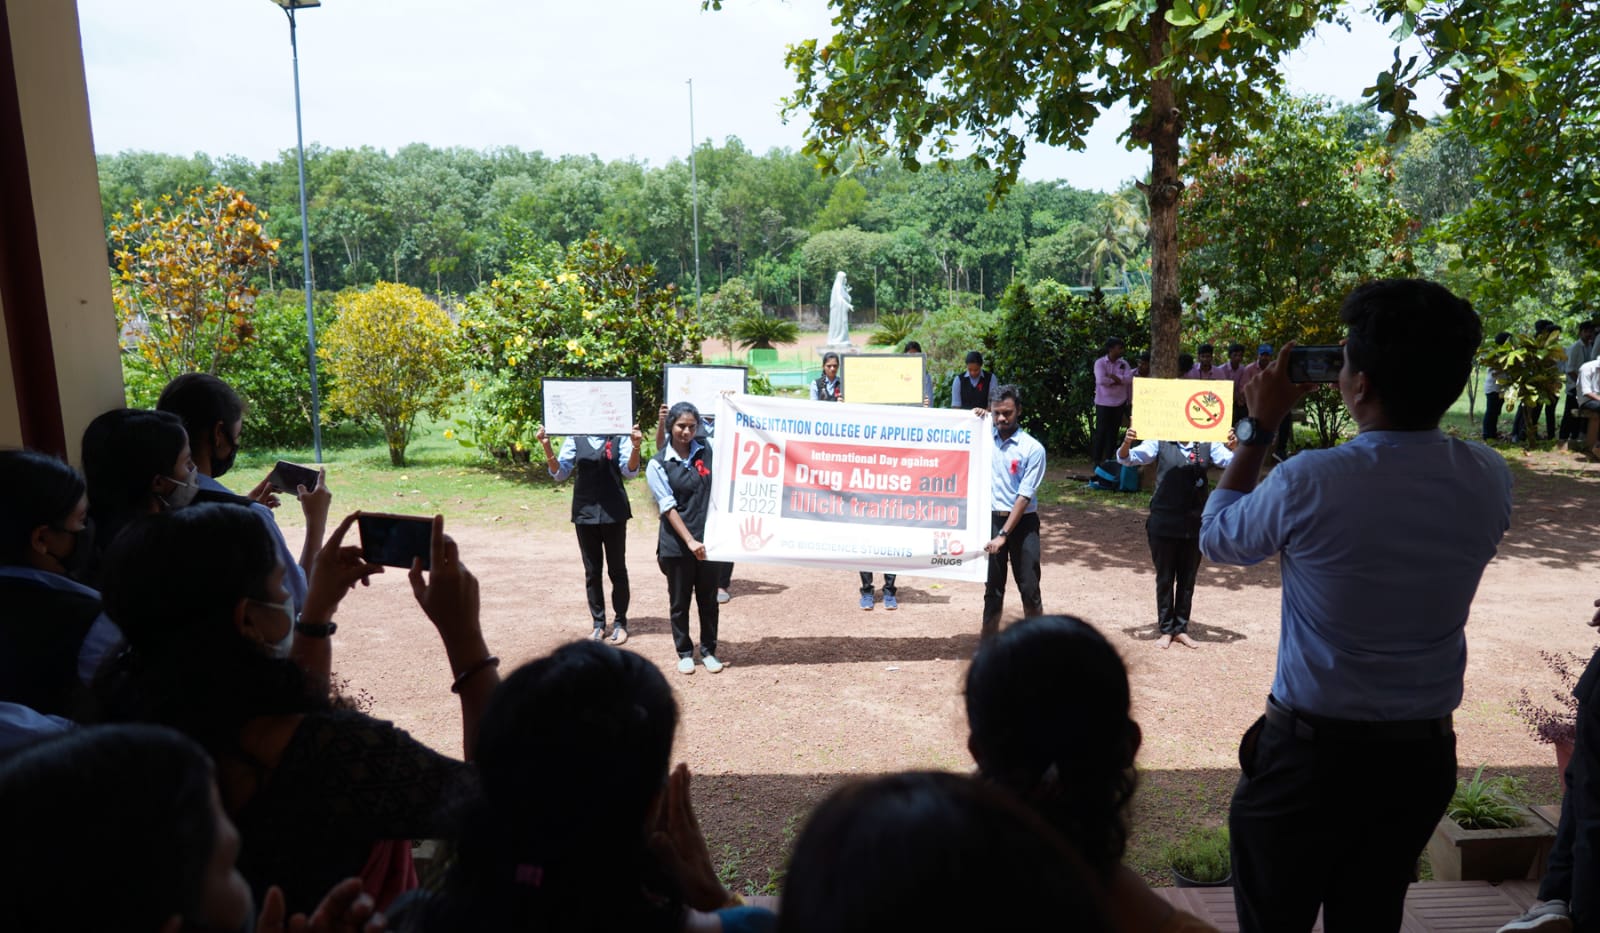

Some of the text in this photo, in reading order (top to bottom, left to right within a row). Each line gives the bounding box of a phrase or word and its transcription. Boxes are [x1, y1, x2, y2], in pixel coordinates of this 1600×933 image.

[736, 411, 971, 444] PRESENTATION COLLEGE OF APPLIED SCIENCE
[741, 440, 780, 478] 26
[811, 449, 939, 468] International Day against
[795, 463, 958, 493] Drug Abuse and
[739, 481, 778, 499] JUNE
[739, 497, 777, 515] 2022
[790, 490, 959, 526] illicit trafficking
[860, 545, 912, 558] STUDENTS
[931, 557, 962, 567] DRUGS
